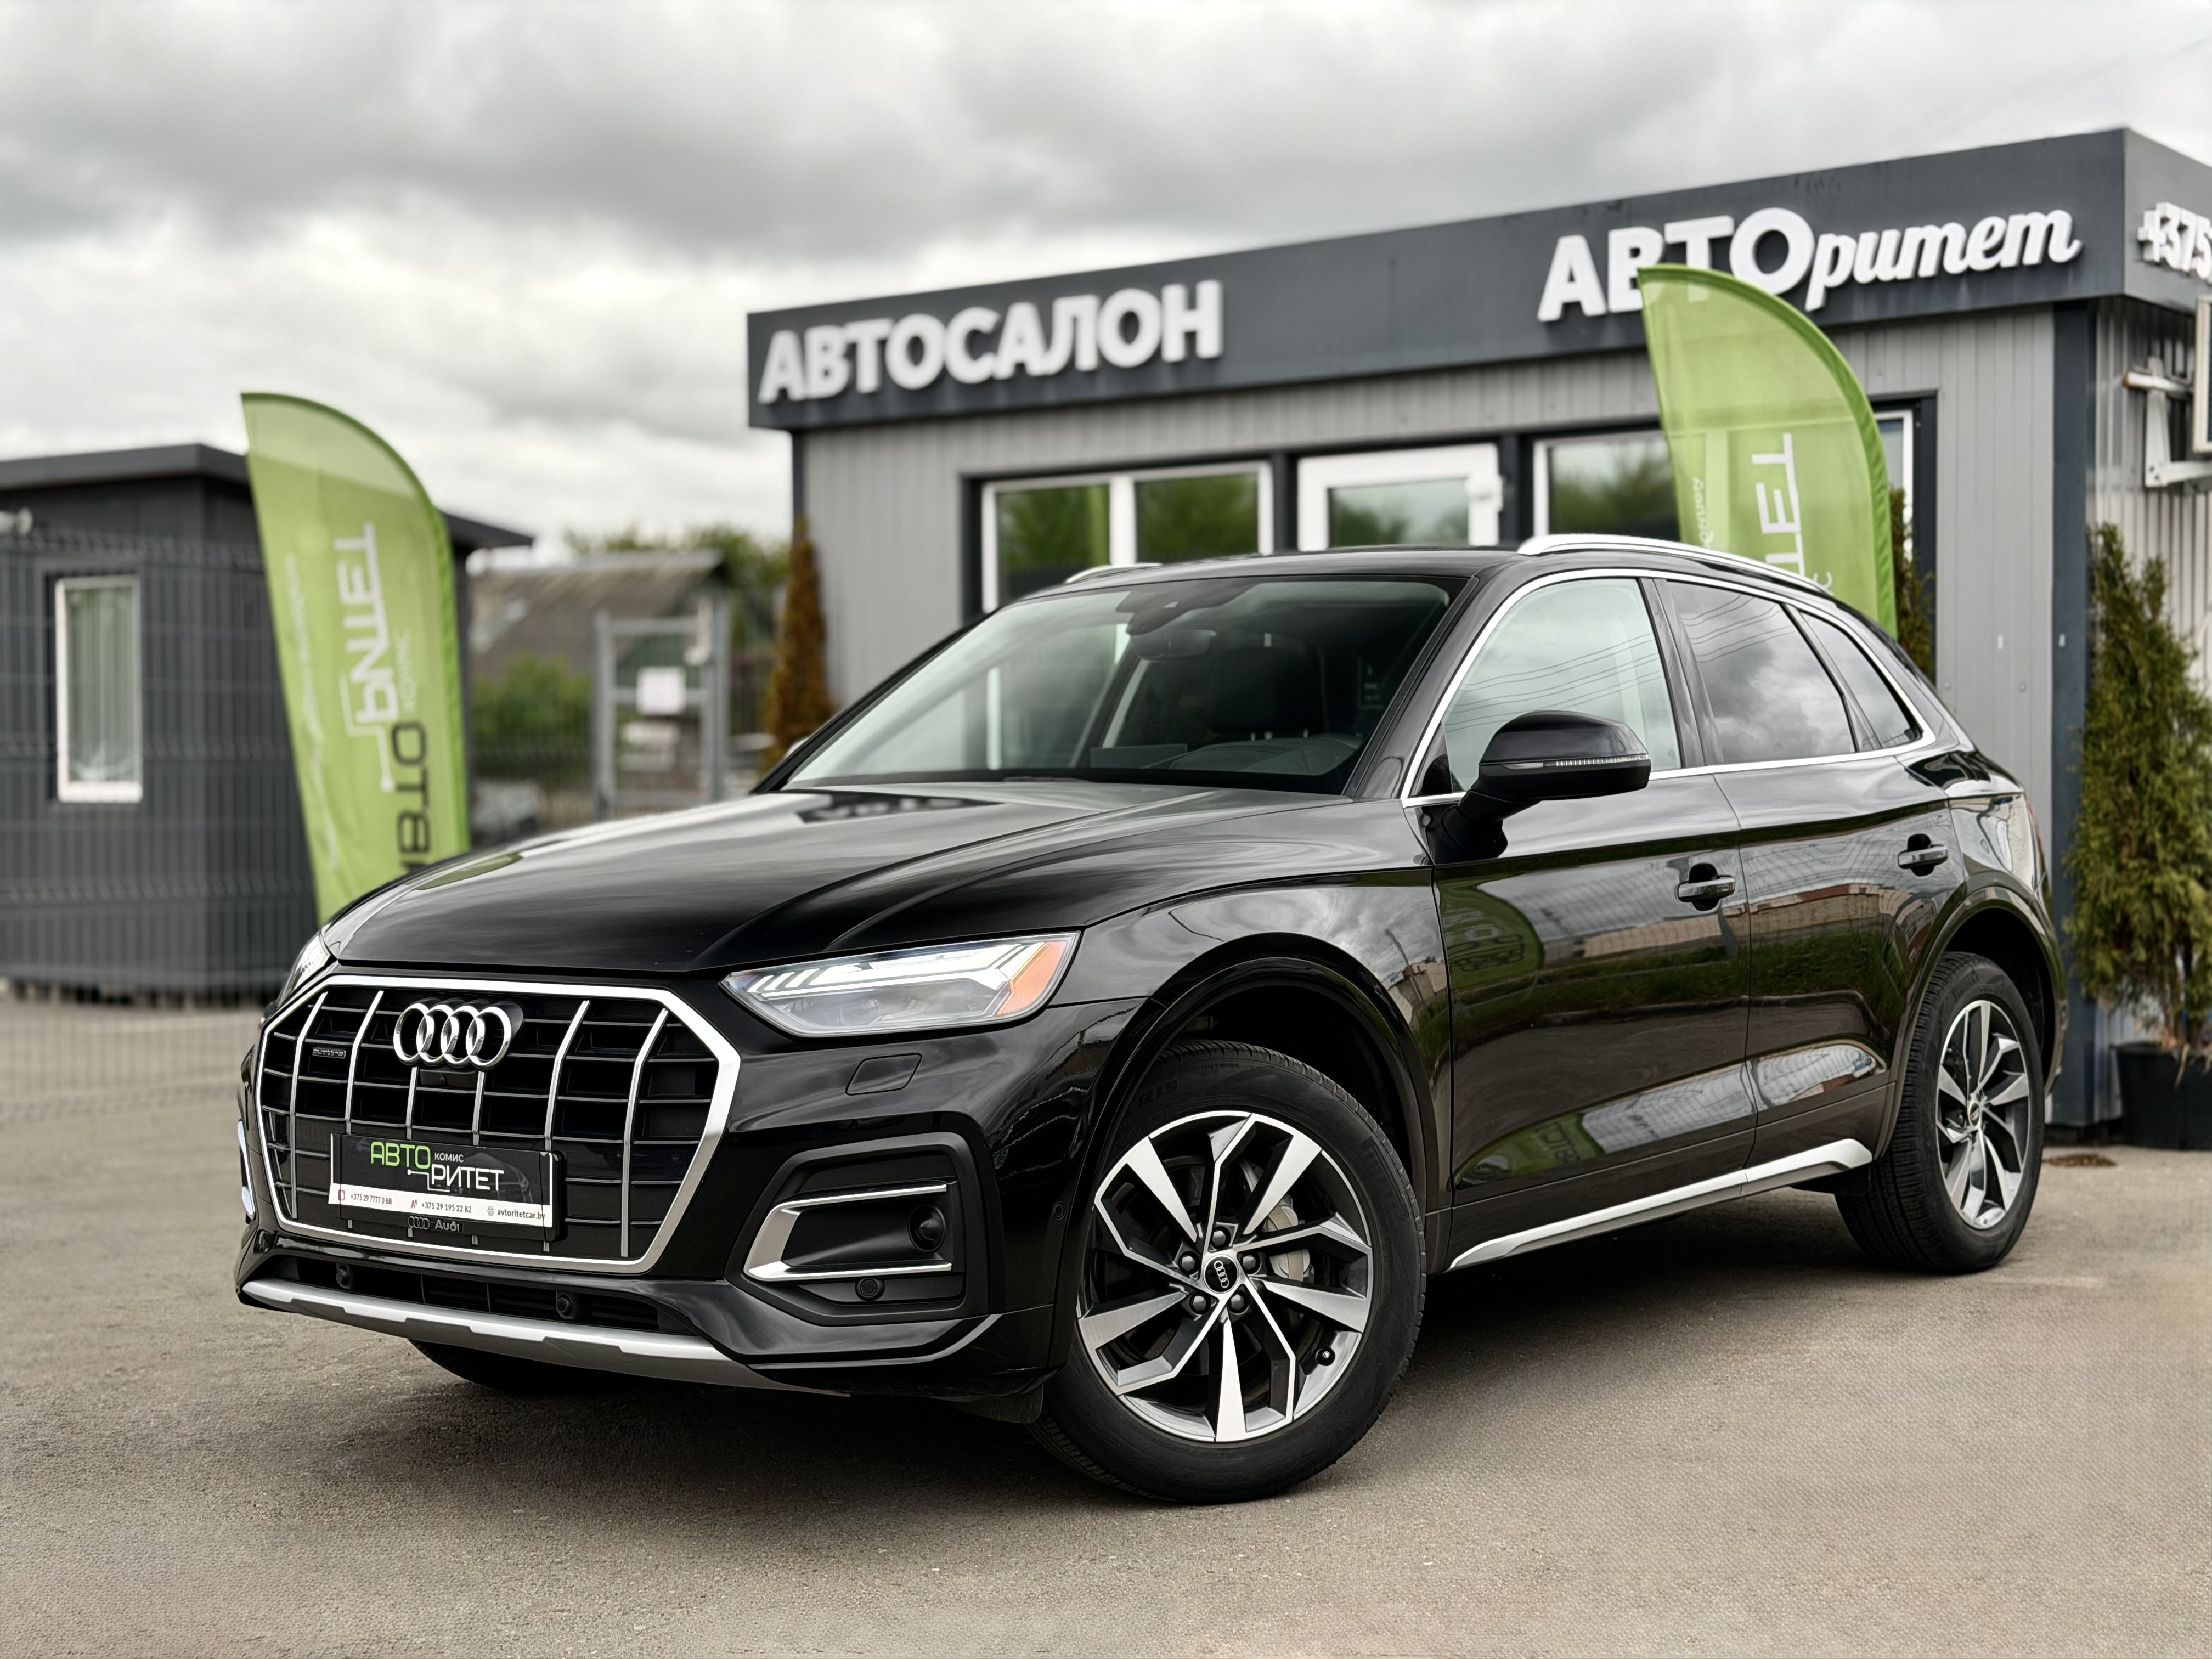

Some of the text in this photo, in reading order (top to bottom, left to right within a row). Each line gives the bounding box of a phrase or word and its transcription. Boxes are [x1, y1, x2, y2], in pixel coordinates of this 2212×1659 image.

[758, 280, 1223, 403] АВТОСАЛОН
[371, 1141, 431, 1169] АВТО
[435, 1152, 464, 1163] КОМИС
[431, 1164, 505, 1191] РИТЕТ
[422, 1201, 435, 1210] +375
[497, 1209, 545, 1220] avtoritetcar.by
[435, 1219, 460, 1232] Audi
